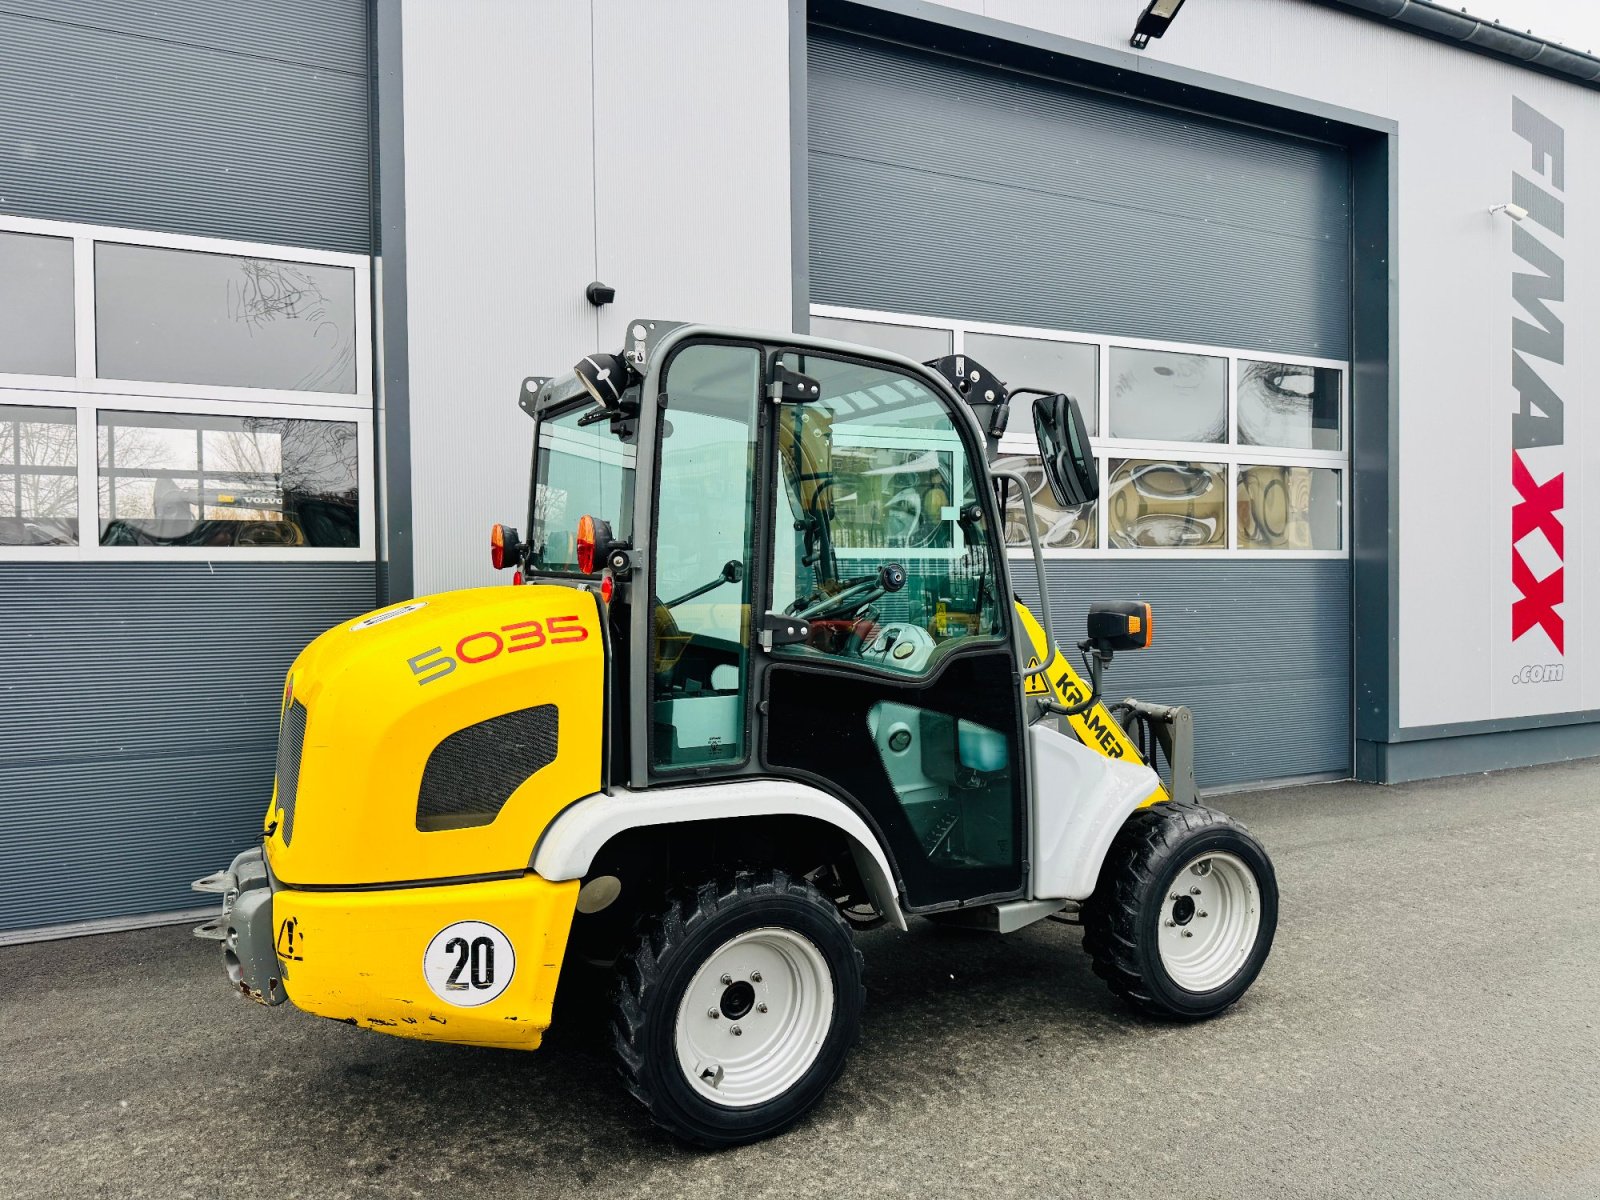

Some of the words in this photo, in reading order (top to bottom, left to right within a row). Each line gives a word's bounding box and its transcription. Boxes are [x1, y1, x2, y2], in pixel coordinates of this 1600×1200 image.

[1512, 94, 1564, 657] FIMAXX
[242, 496, 283, 505] VOLVO
[407, 615, 588, 686] 5035
[1512, 664, 1564, 684] .com
[445, 936, 494, 991] 20
